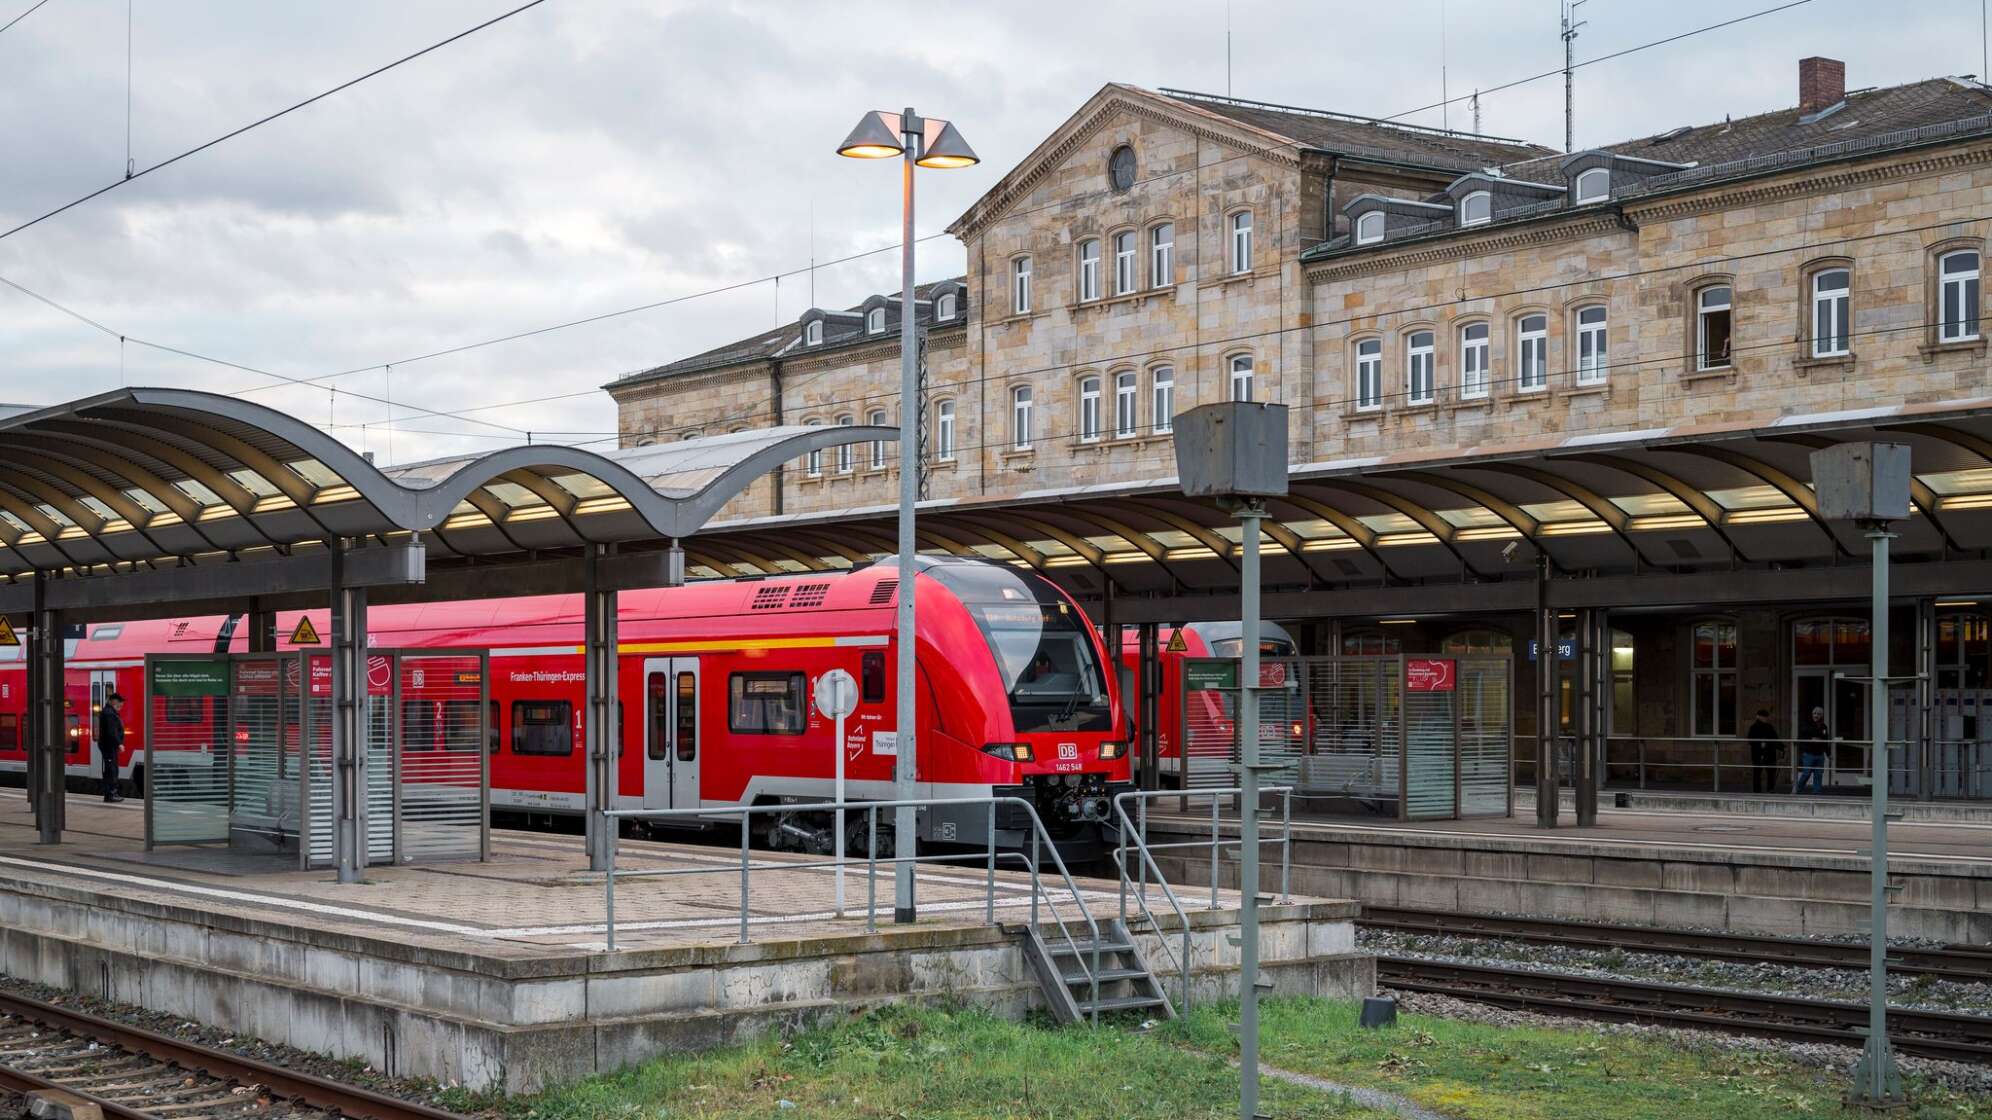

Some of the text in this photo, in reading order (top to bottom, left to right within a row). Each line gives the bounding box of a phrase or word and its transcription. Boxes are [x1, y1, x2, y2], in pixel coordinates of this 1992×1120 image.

[510, 671, 586, 684] Franken-Thüringen-Express
[1059, 744, 1077, 758] DB
[1056, 763, 1070, 771] 1462
